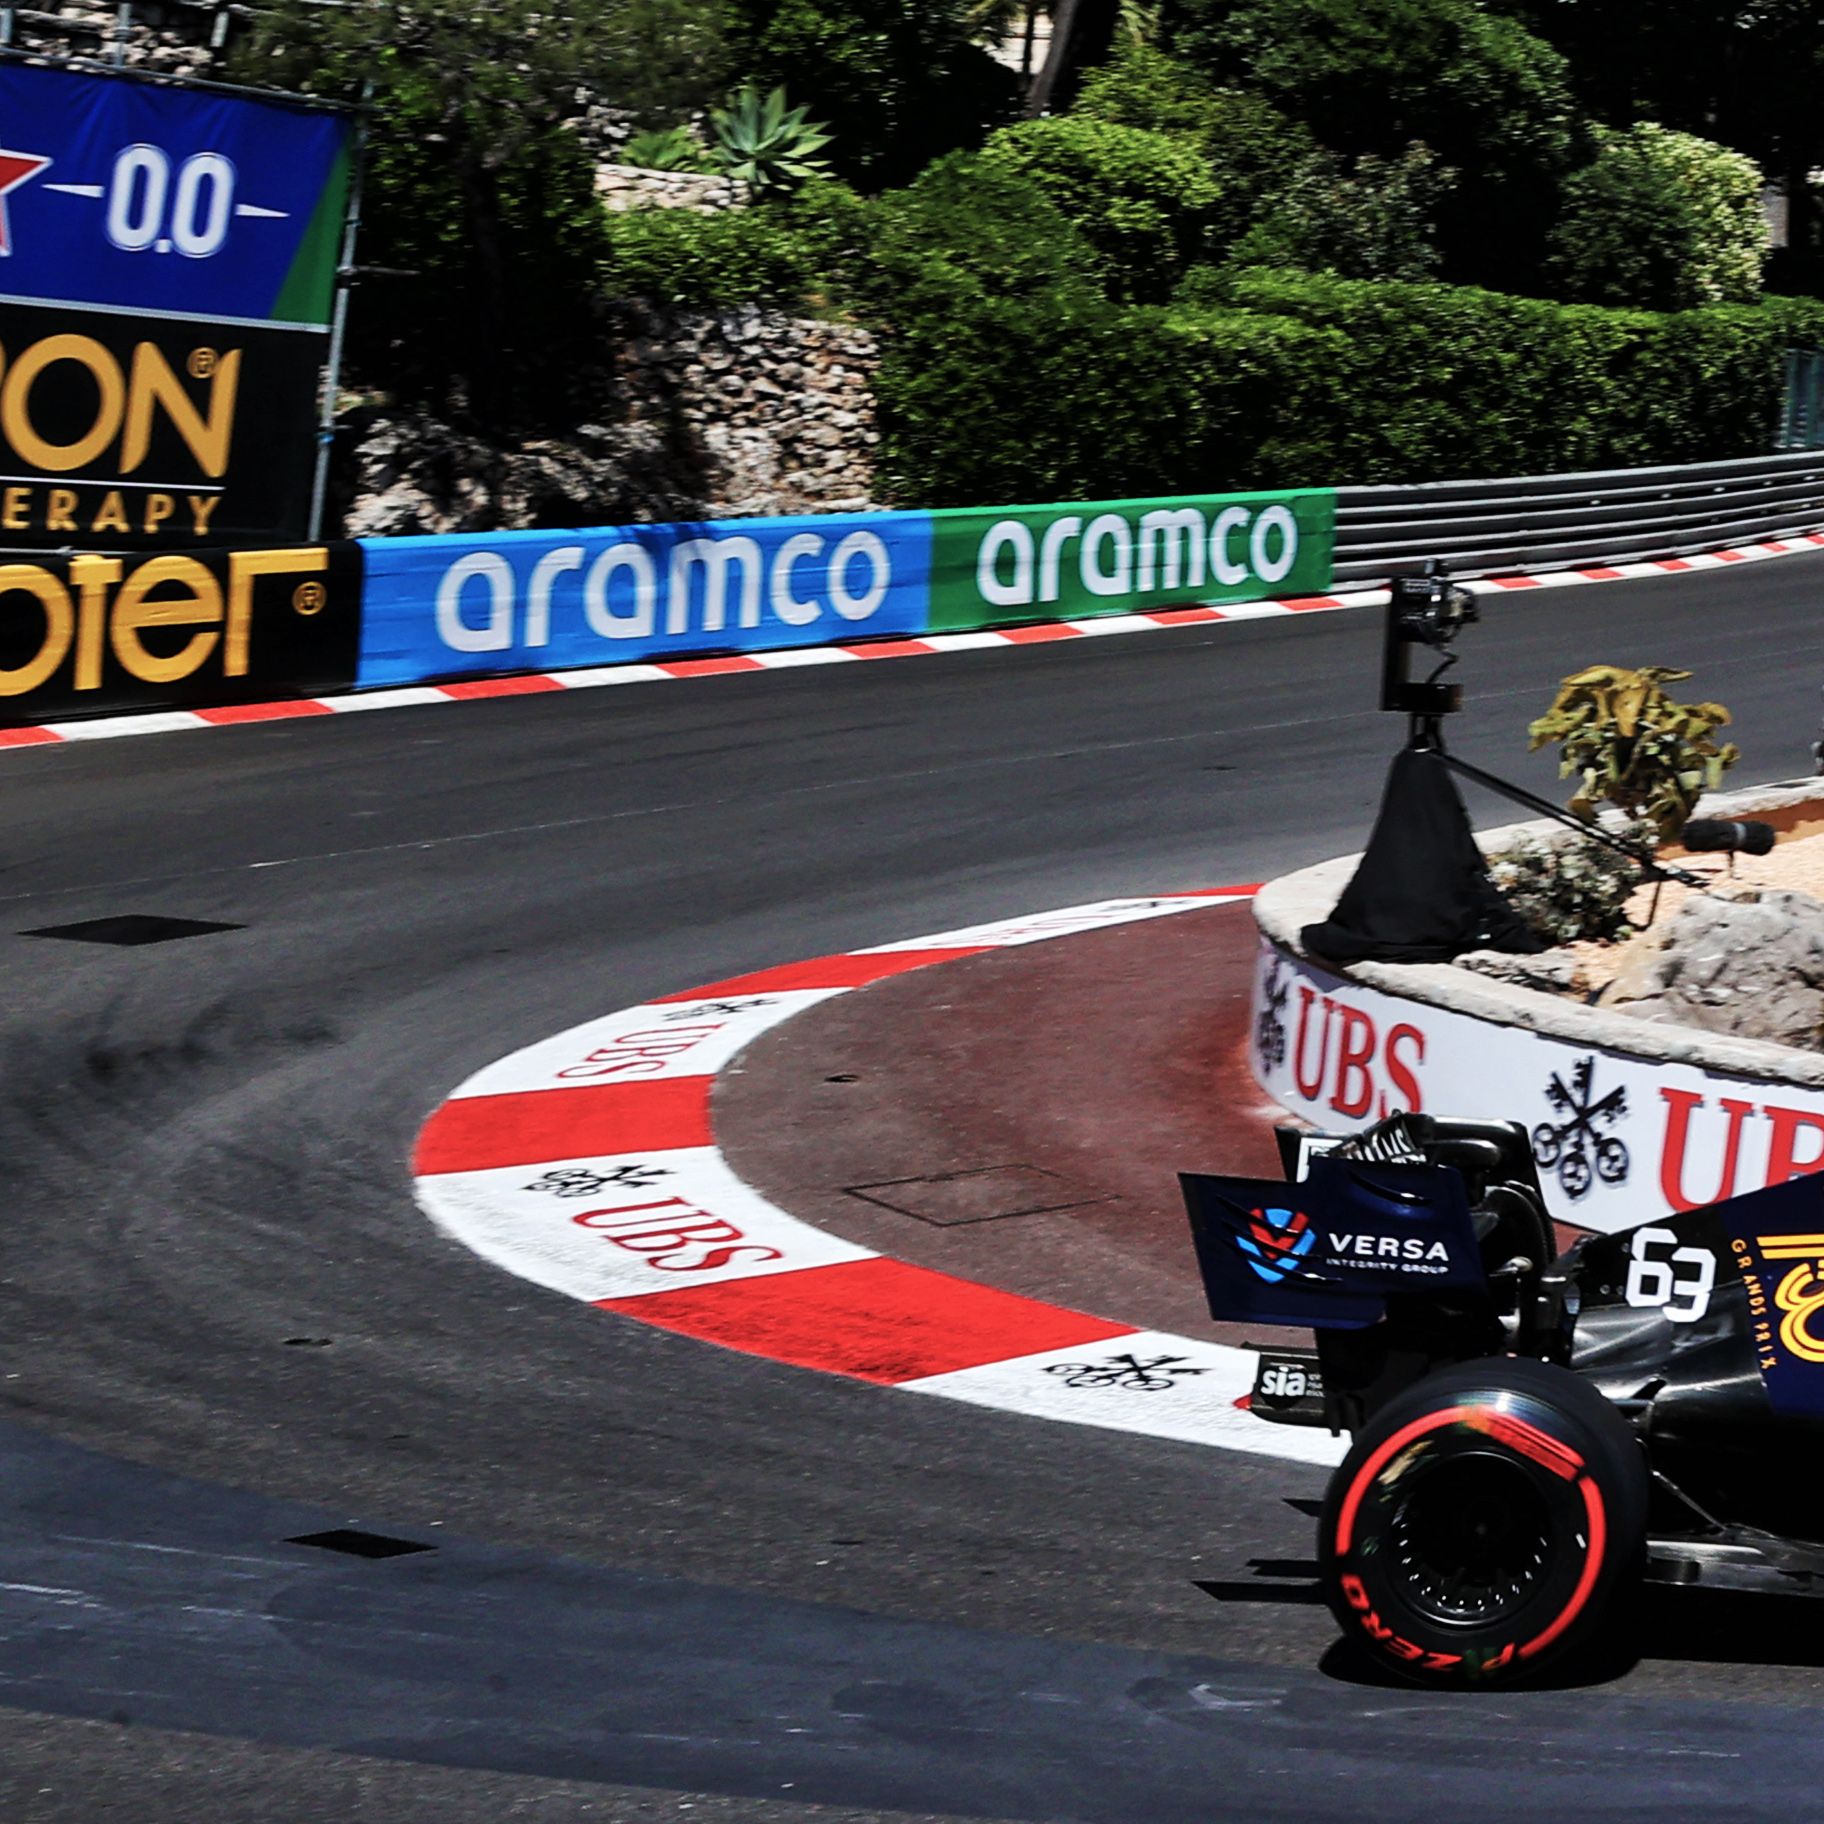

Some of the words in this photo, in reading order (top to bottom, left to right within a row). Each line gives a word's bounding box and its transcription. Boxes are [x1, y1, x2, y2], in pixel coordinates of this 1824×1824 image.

[435, 529, 890, 653] aramco
[977, 505, 1298, 606] aramco
[555, 1021, 729, 1079] UBS
[1294, 986, 1427, 1120] UBS
[569, 1195, 785, 1272] UBS
[1329, 1233, 1450, 1262] VERSA
[1625, 1227, 1717, 1323] 63
[1731, 1238, 1767, 1317] GRANDS
[1753, 1321, 1777, 1370] PRIX
[1261, 1366, 1307, 1396] sia
